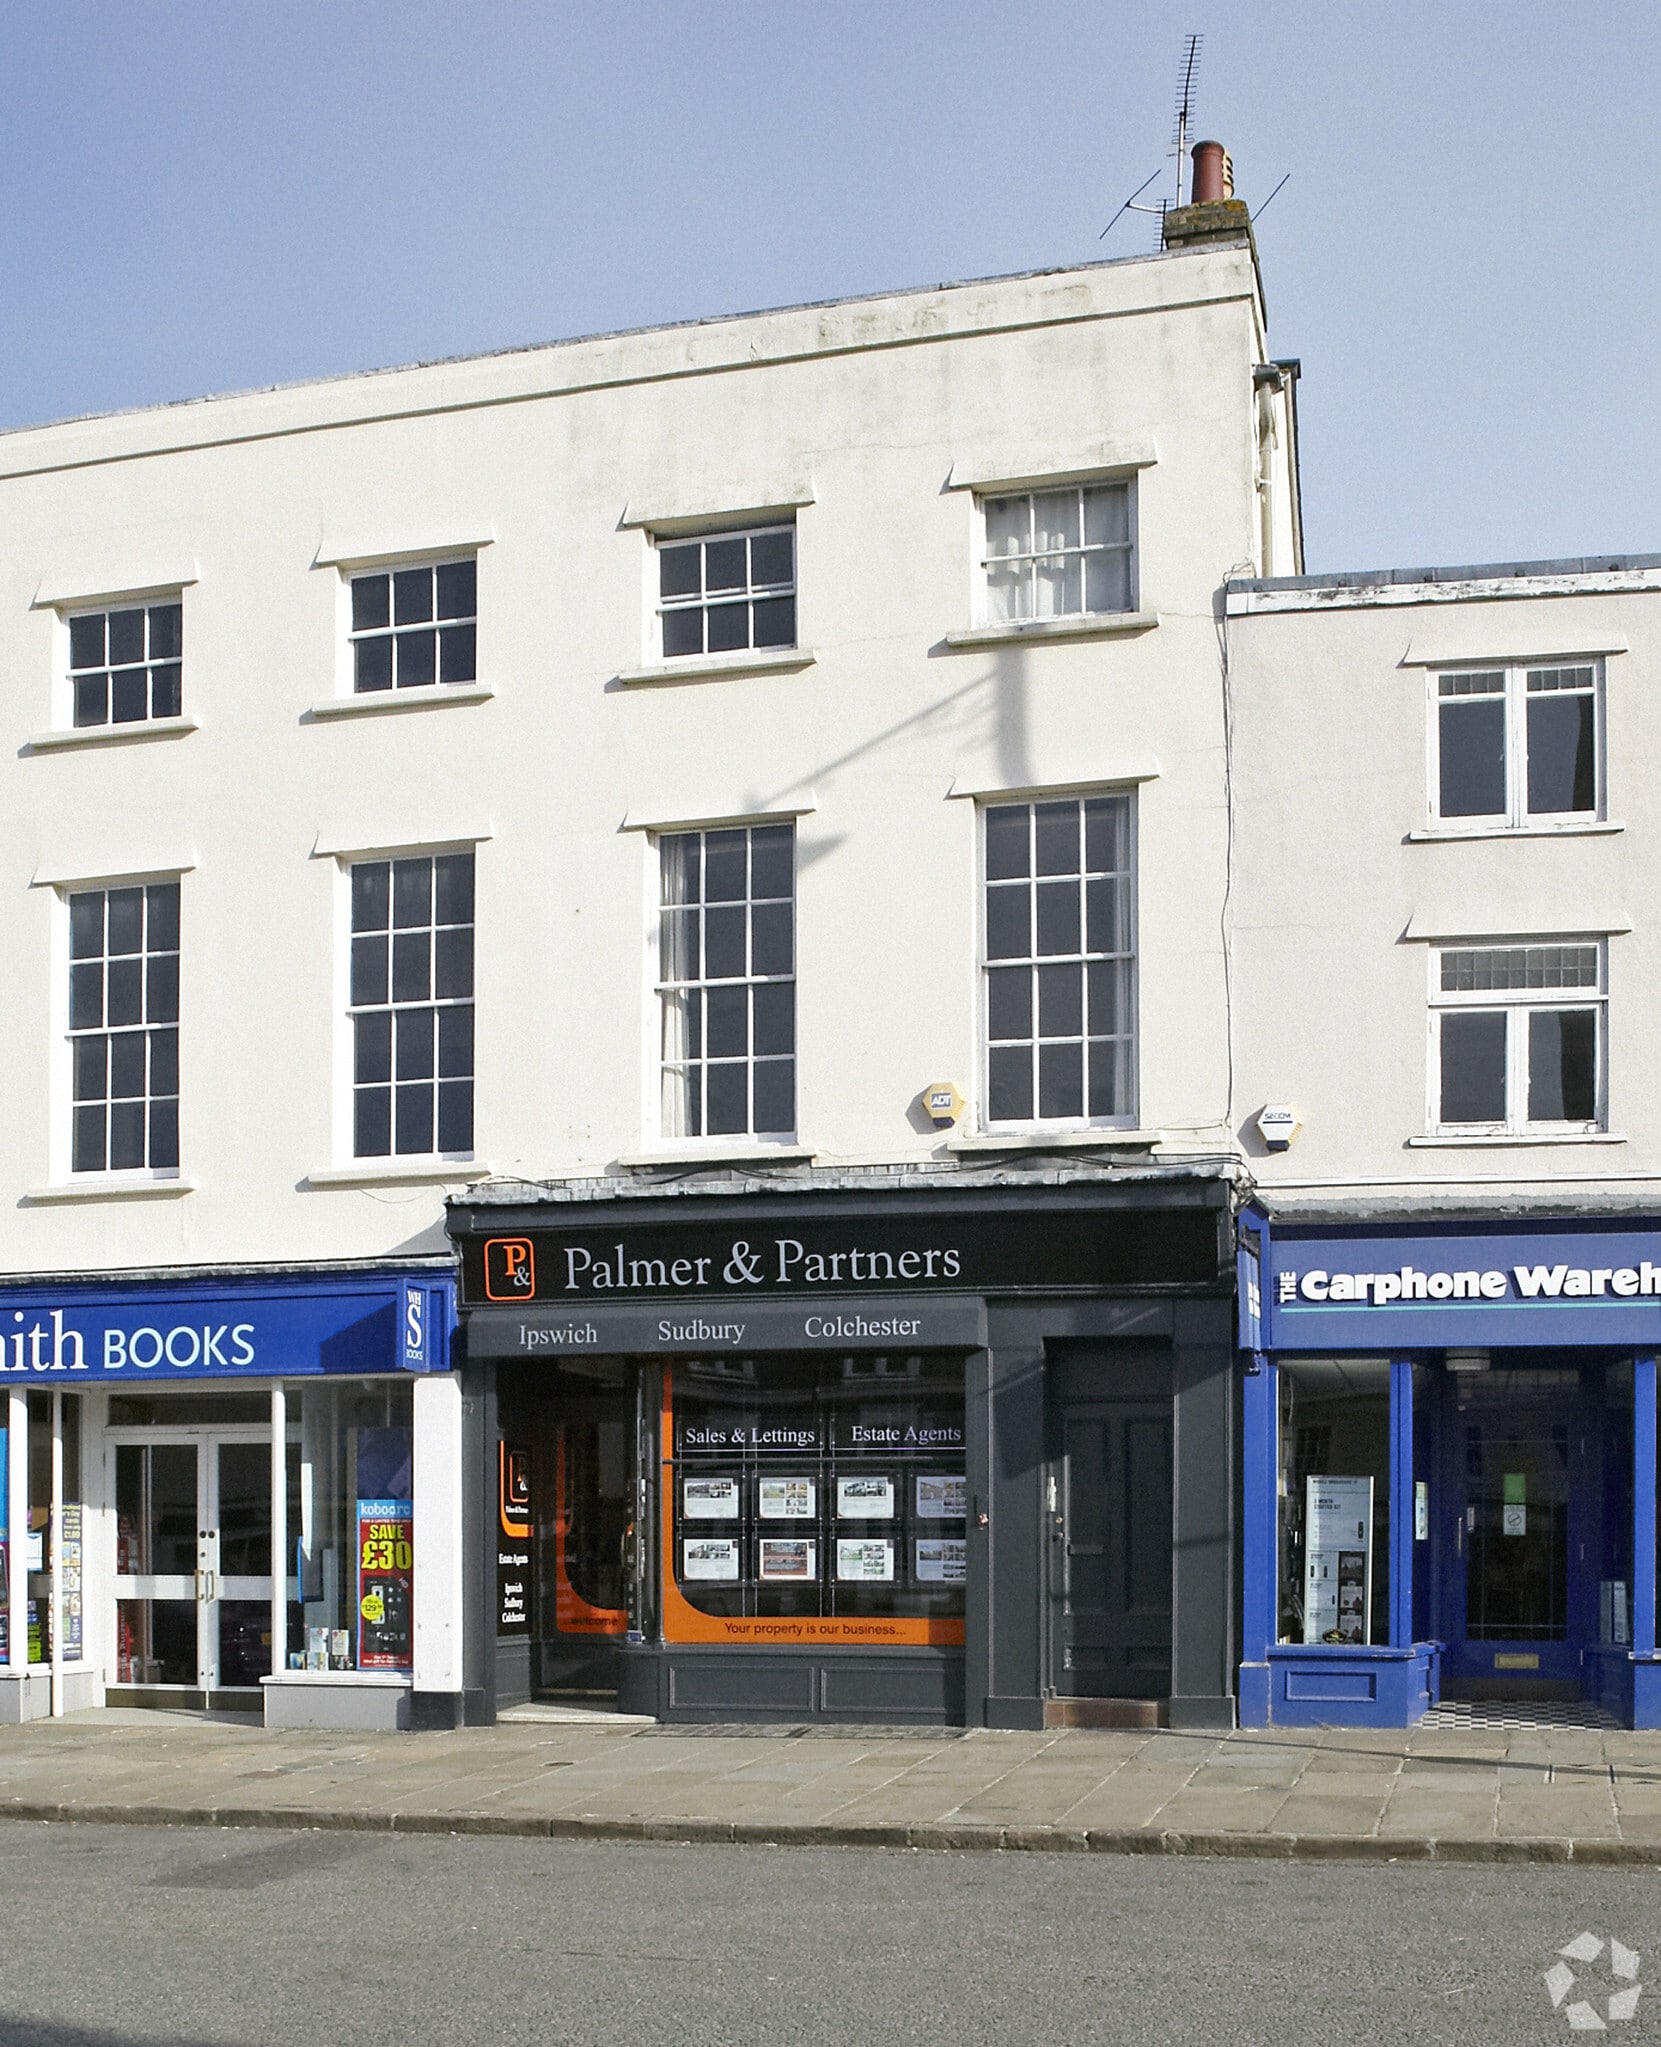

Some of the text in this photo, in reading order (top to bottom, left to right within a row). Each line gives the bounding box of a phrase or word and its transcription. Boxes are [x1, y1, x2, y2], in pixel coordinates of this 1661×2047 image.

[931, 1095, 952, 1106] ADT
[503, 1244, 527, 1277] P
[563, 1239, 961, 1290] Palmer & Partners
[513, 1266, 532, 1287] &
[1279, 1271, 1297, 1304] THE
[1300, 1266, 1508, 1305] Carphone
[1513, 1261, 1661, 1297] Wareh
[407, 1290, 422, 1305] WH
[406, 1303, 423, 1349] S
[518, 1315, 921, 1350] Ipswich Sudbury Colchester
[103, 1323, 255, 1369] BOOKS
[685, 1427, 816, 1447] Sales & Lettings
[852, 1425, 962, 1442] Estate Agents
[369, 1524, 404, 1540] SAVE
[361, 1540, 412, 1570] £30
[724, 1623, 907, 1636] Your property is our business...
